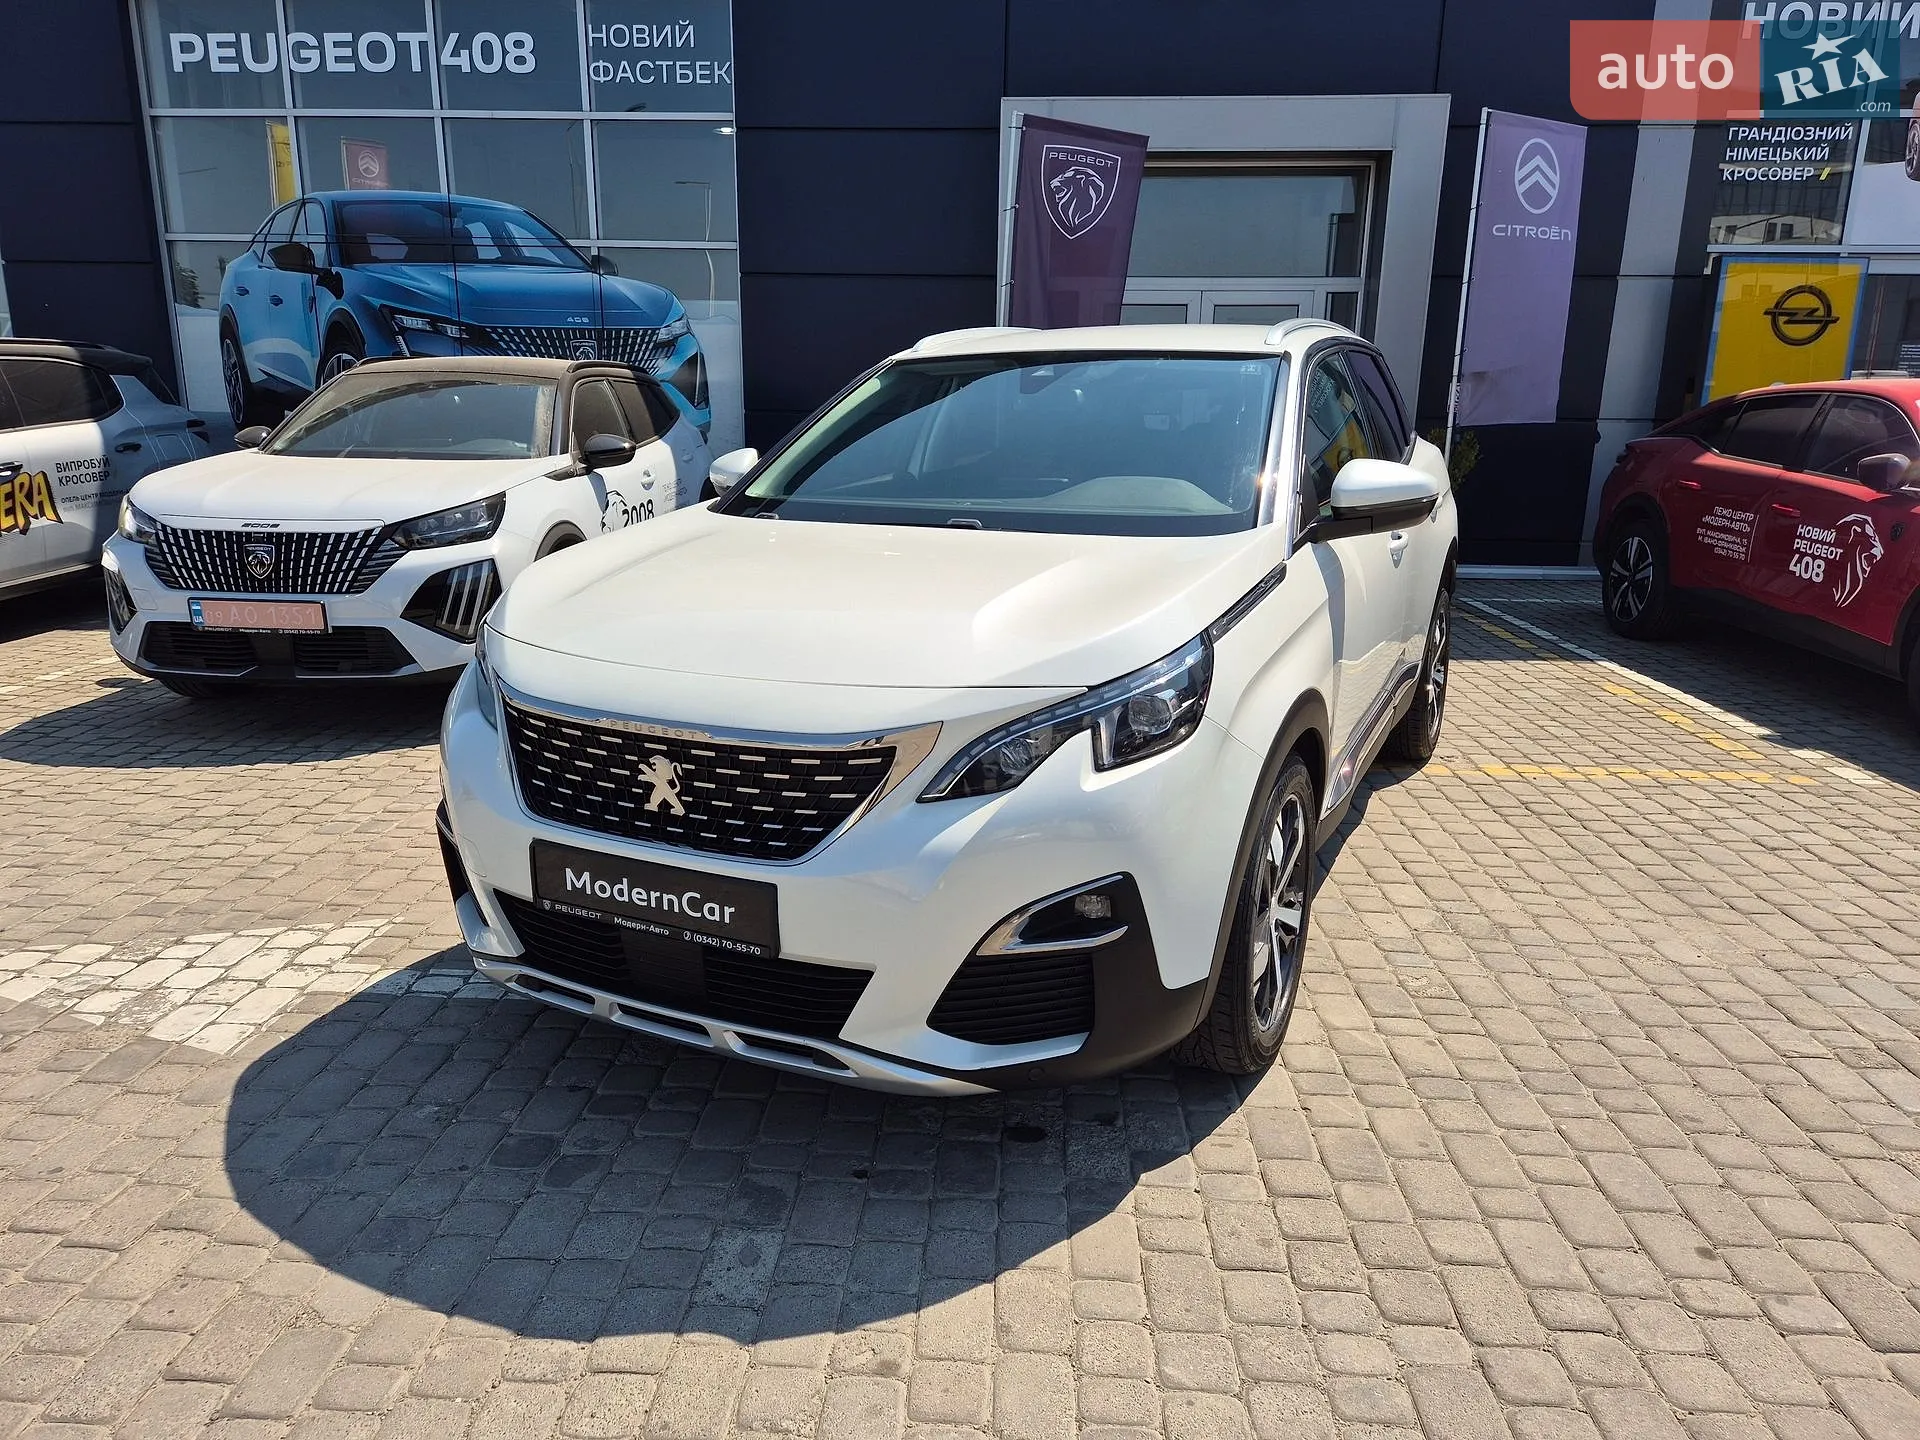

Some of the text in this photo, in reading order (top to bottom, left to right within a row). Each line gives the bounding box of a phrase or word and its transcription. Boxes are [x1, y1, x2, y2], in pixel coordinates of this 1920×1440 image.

[588, 19, 695, 48] НОВИЙ
[169, 32, 536, 74] PEUGEOT 408
[589, 60, 732, 84] ФАСТБЕК
[1728, 122, 1853, 143] ГРАНДІОЗНИЙ
[1049, 152, 1114, 167] PEUGEOT
[1725, 143, 1830, 163] НІМЕЦЬКИЙ
[1722, 167, 1815, 181] КРОСОВЕР
[55, 454, 111, 473] ВИПРОБУЙ
[58, 470, 110, 487] КРОСОВЕР
[622, 499, 655, 527] 2008
[1714, 506, 1754, 521] ПЕЖО ЦЕНТР
[1797, 524, 1836, 543] НОВИЙ
[1793, 539, 1843, 560] PEUGEOT
[1789, 554, 1825, 583] 408
[610, 720, 697, 739] PEUGEOT
[565, 867, 735, 924] ModernCar
[555, 903, 761, 955] PEUGEOT Модерн-Авто (0342) 70-55-70
